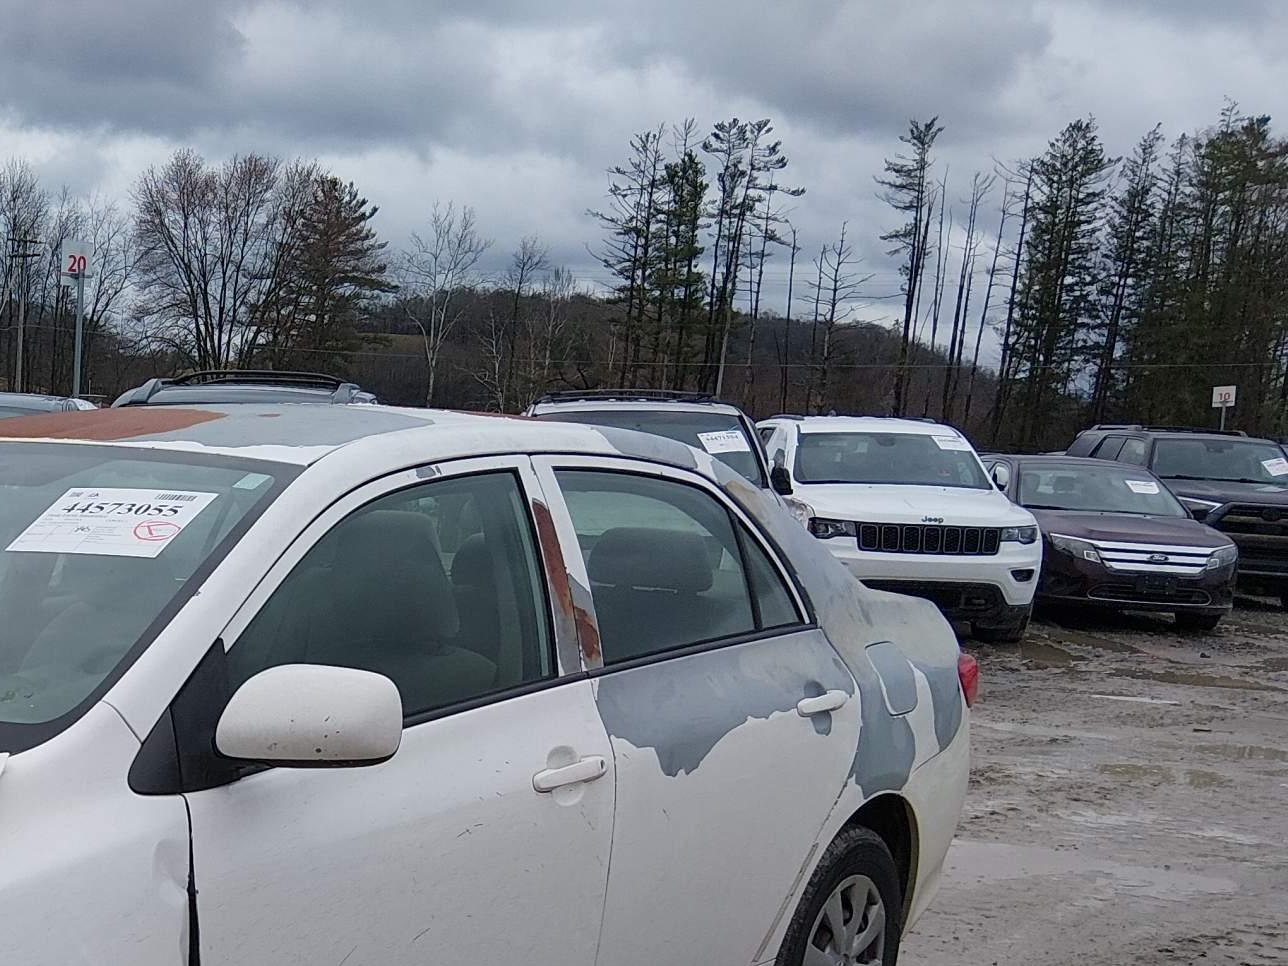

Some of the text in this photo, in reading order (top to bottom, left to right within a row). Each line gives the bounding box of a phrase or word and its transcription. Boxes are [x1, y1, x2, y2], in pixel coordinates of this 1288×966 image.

[67, 254, 87, 272] 20
[1218, 392, 1231, 401] 10
[61, 501, 184, 517] 44573055
[921, 515, 944, 524] Jeep
